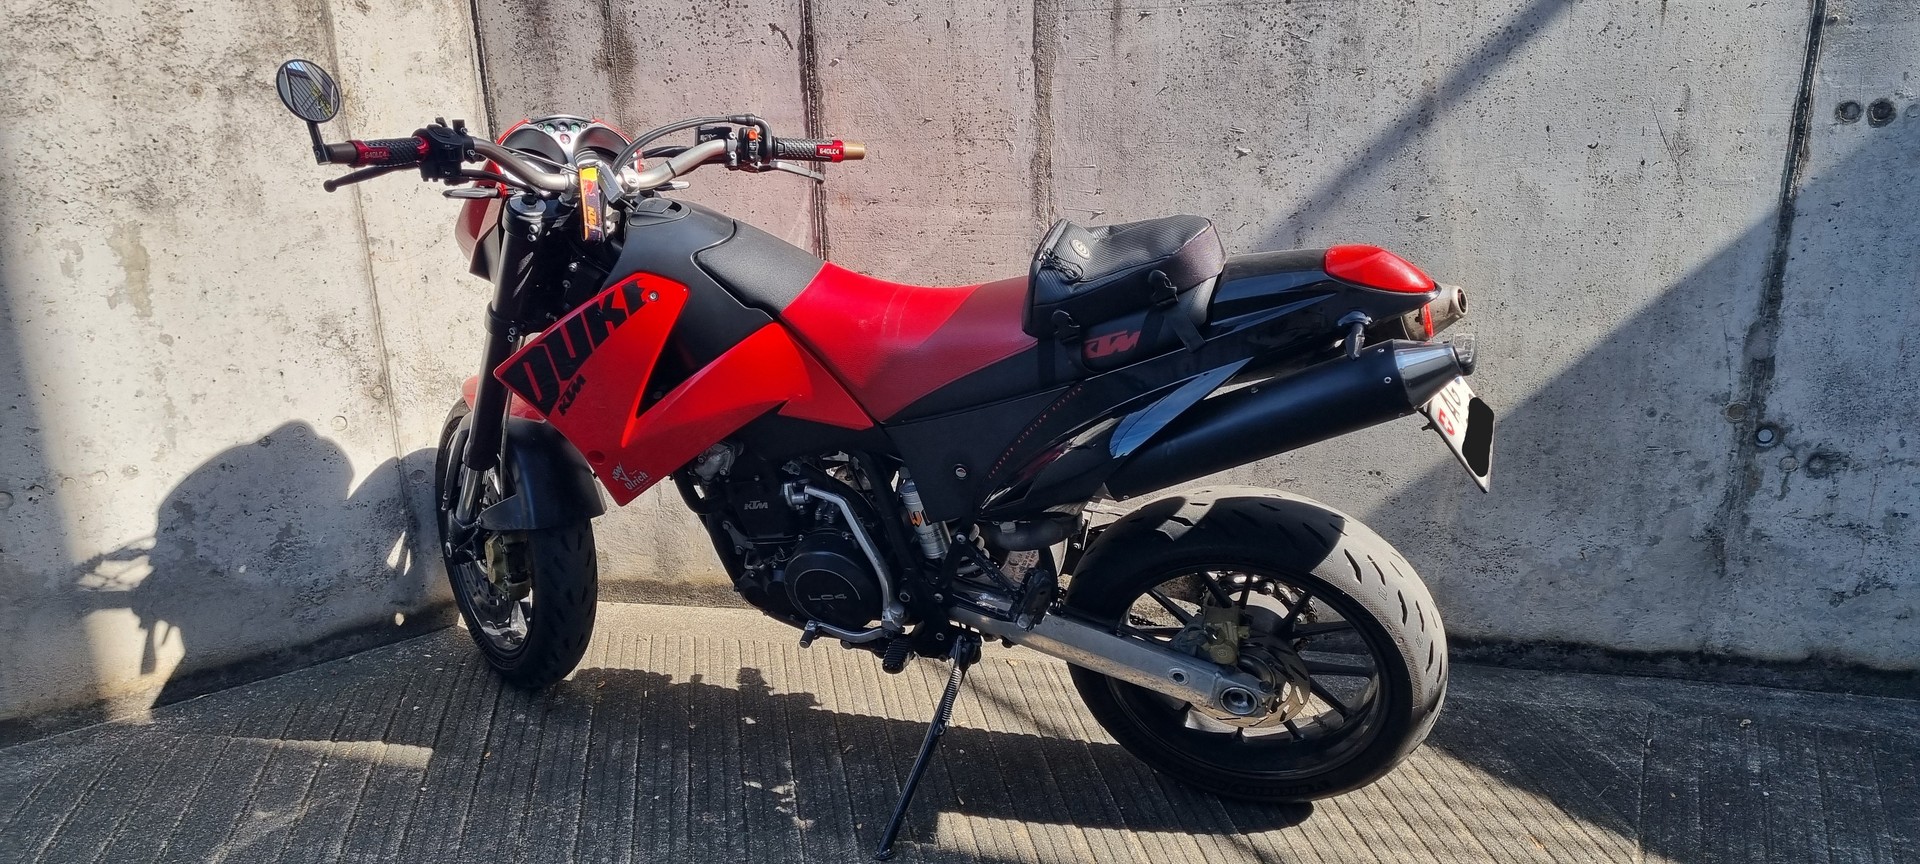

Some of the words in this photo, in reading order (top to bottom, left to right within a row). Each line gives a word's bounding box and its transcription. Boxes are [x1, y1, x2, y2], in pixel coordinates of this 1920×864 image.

[501, 279, 648, 417] DUKE
[1084, 330, 1141, 359] KTM
[558, 374, 587, 416] KTM
[1440, 387, 1462, 424] AG
[744, 500, 769, 510] KTM
[808, 593, 848, 601] LC4
